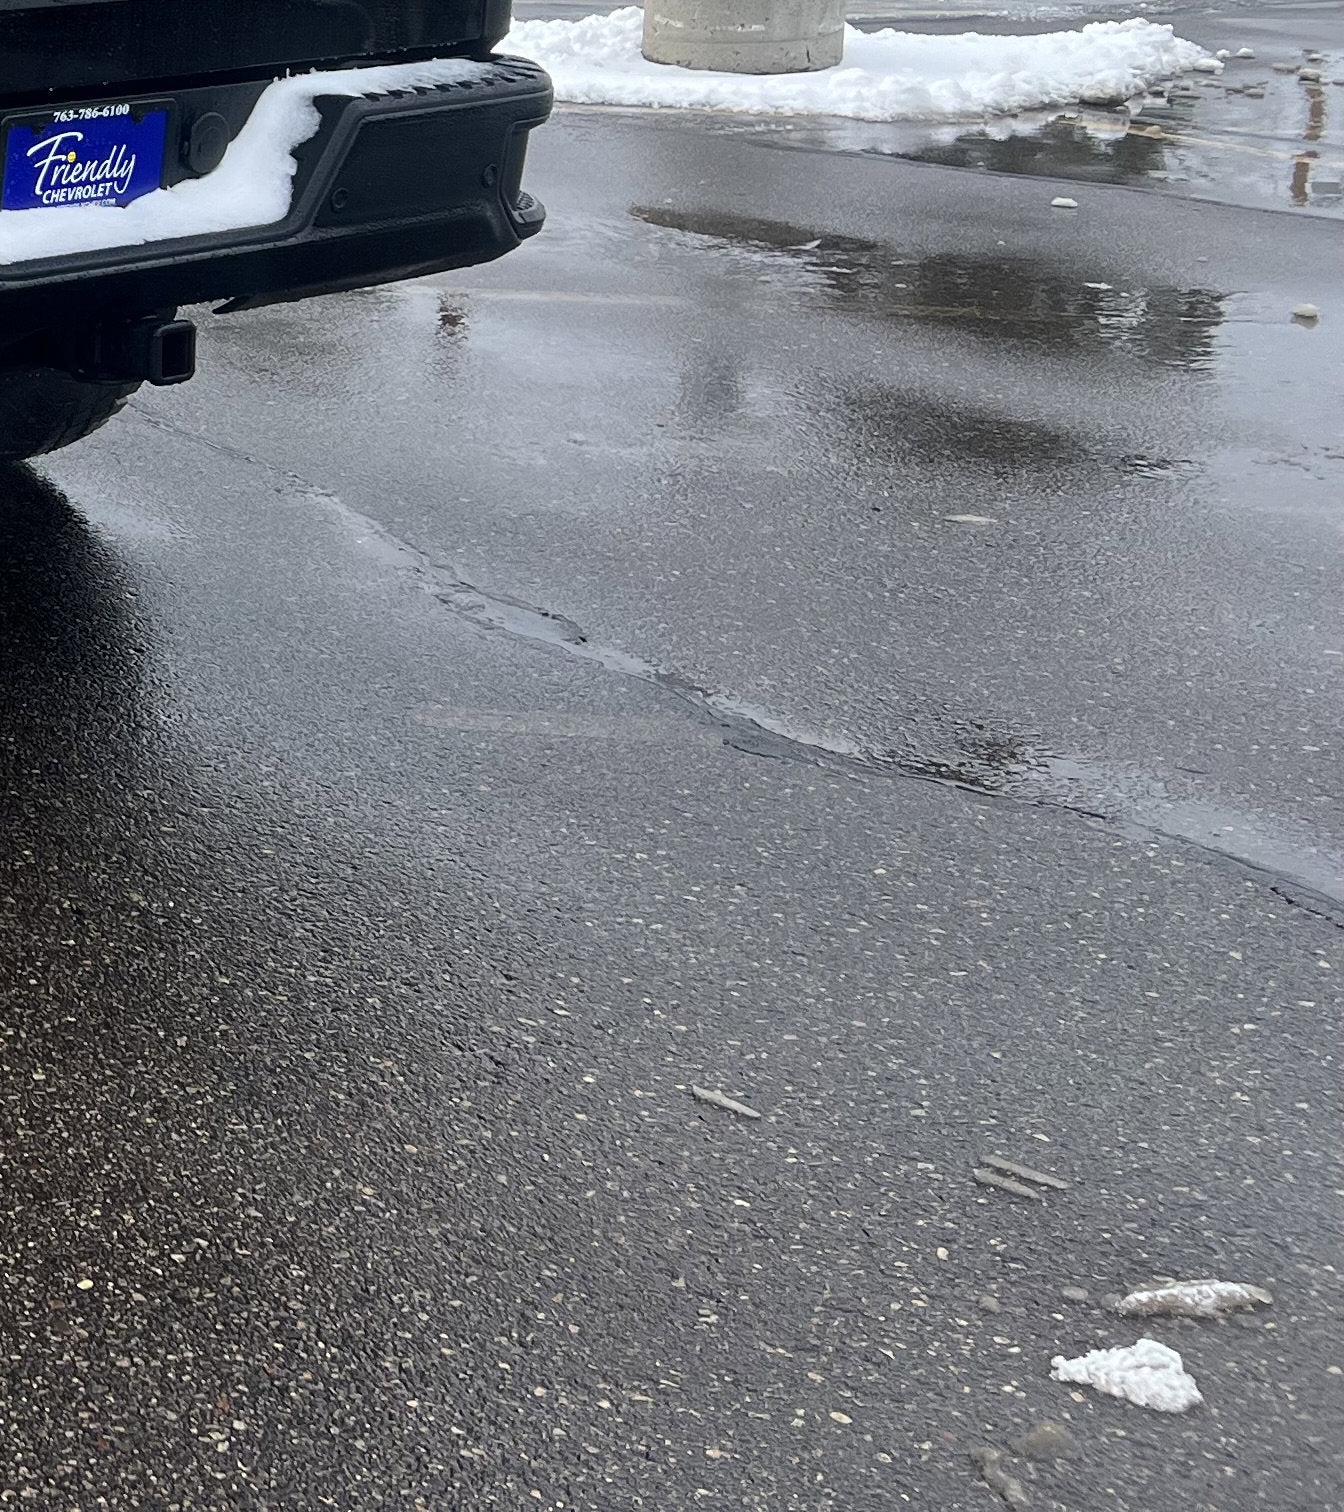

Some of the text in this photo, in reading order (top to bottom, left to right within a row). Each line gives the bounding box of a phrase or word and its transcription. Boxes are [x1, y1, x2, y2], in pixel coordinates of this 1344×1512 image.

[53, 103, 130, 123] 763-786-6100
[26, 131, 136, 195] Friendly
[42, 182, 113, 204] CHEVROLET
